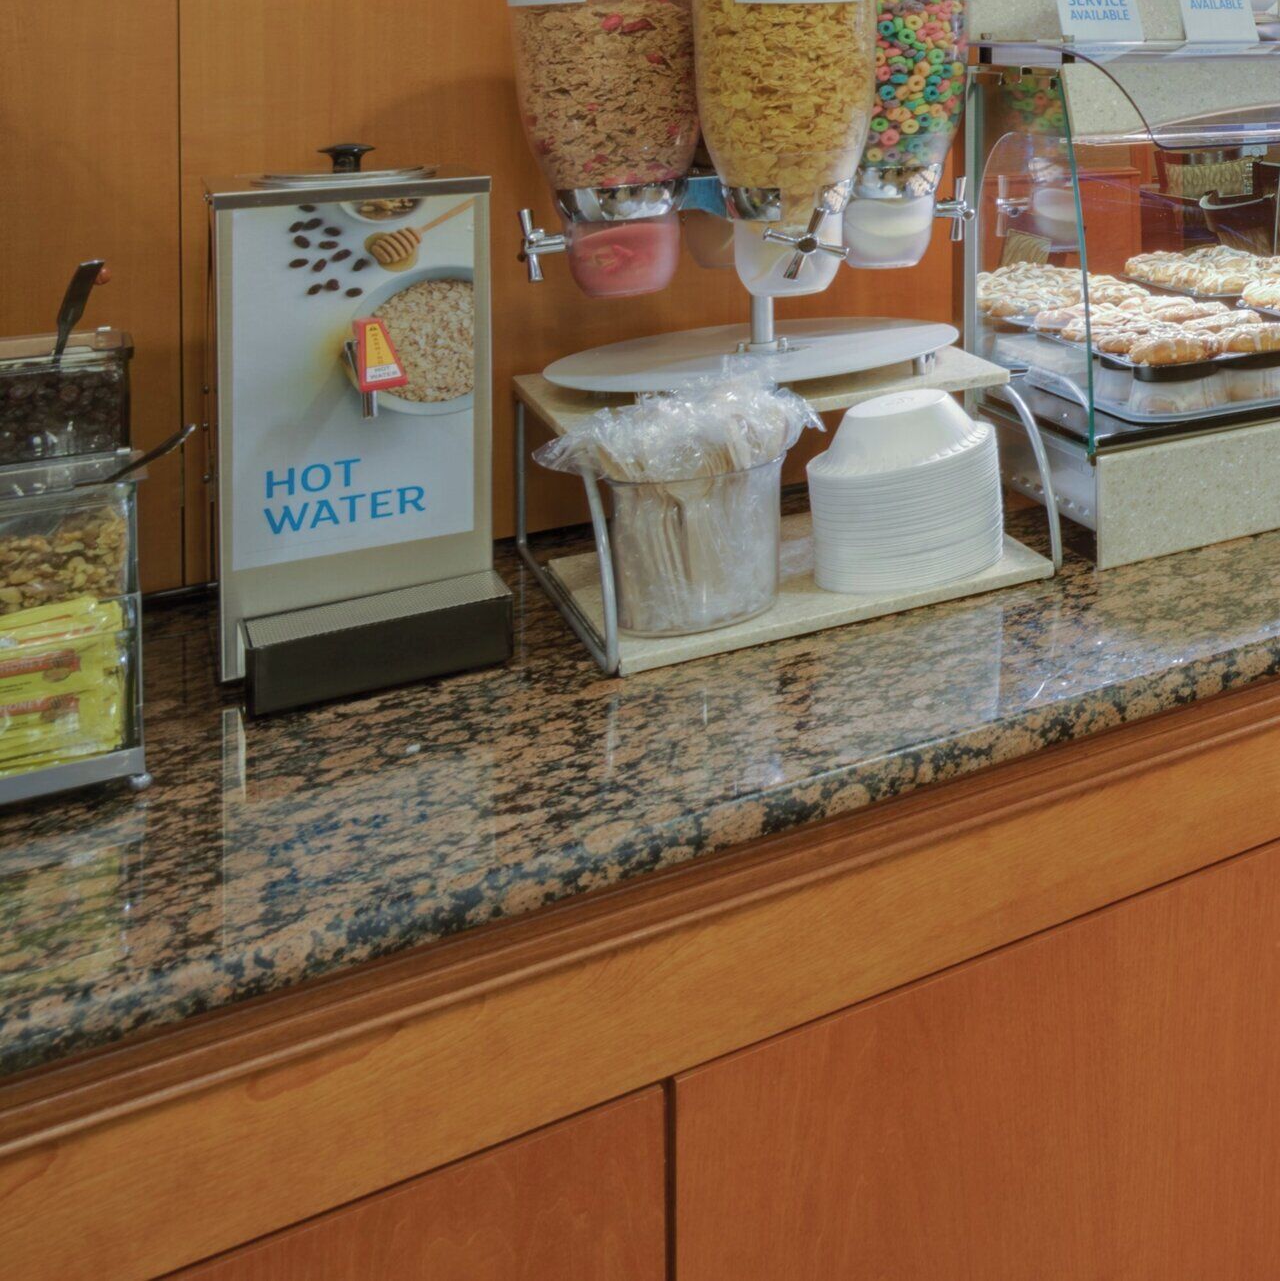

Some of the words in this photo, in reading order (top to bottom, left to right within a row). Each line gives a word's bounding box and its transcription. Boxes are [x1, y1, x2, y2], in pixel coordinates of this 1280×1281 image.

[1070, 8, 1131, 21] AVAILABLE
[266, 458, 361, 499] HOT
[263, 486, 426, 535] WATER
